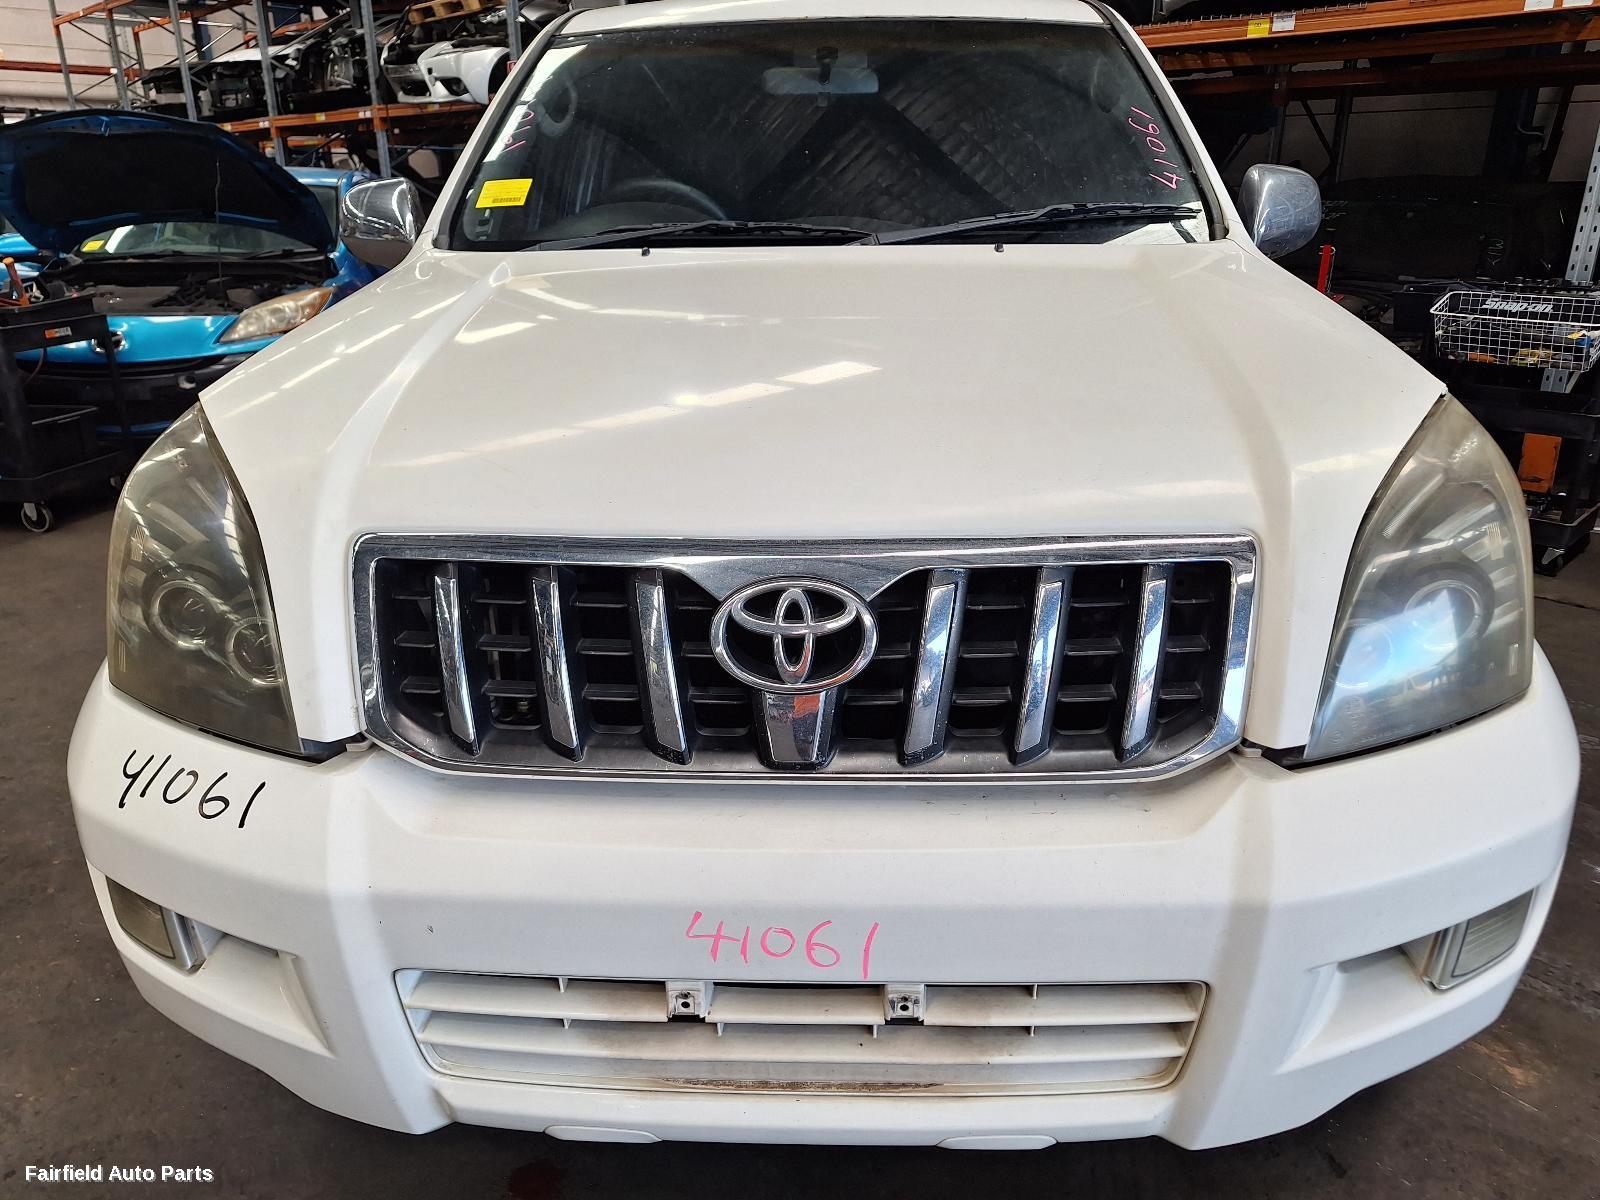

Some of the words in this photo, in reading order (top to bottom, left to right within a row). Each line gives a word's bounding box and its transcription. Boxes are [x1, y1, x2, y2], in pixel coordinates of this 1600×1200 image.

[1128, 106, 1186, 190] 41061
[1481, 297, 1554, 313] Snap-on
[118, 749, 266, 829] 41061
[687, 911, 880, 980] 41061
